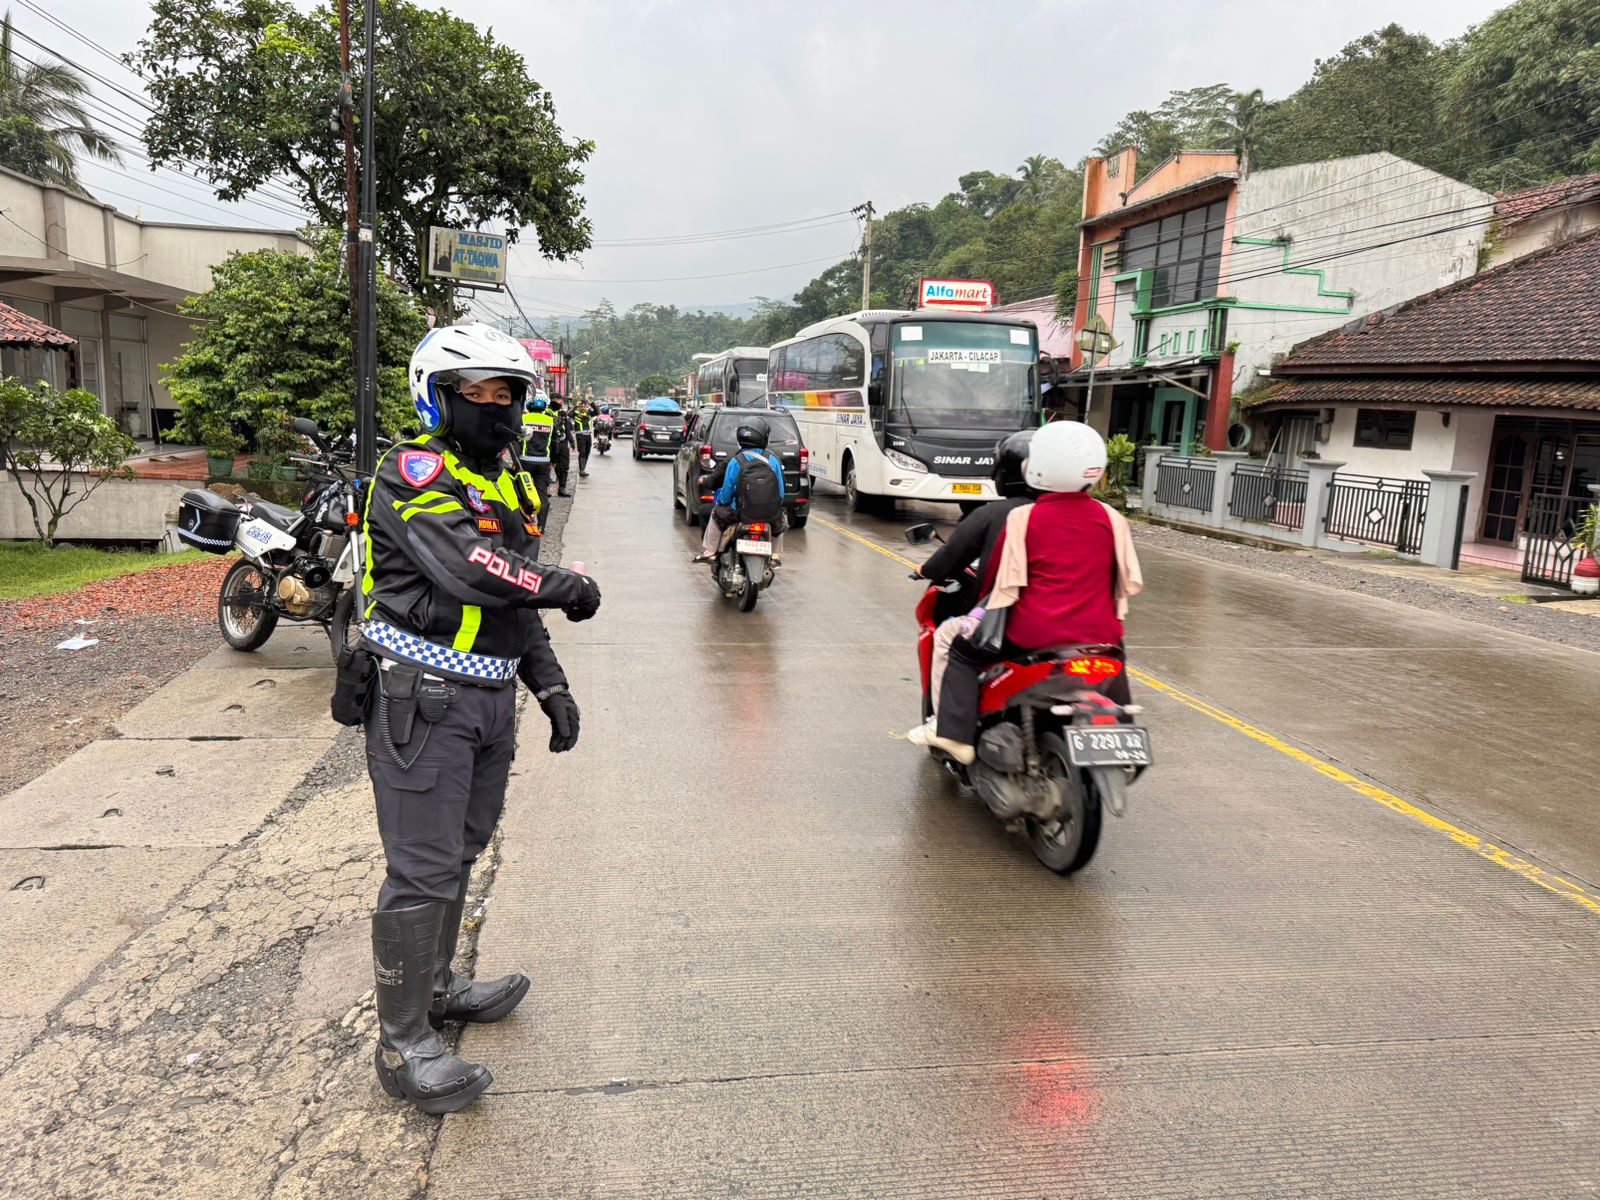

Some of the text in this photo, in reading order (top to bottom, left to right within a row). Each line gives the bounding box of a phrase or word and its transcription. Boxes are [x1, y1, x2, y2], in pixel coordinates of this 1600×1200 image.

[458, 233, 503, 249] MASJID
[926, 285, 989, 299] Alfamart
[930, 351, 963, 361] JAKARTA
[968, 351, 999, 361] CILACAP
[933, 456, 995, 466] SINAR JAY
[467, 545, 543, 594] POLISI
